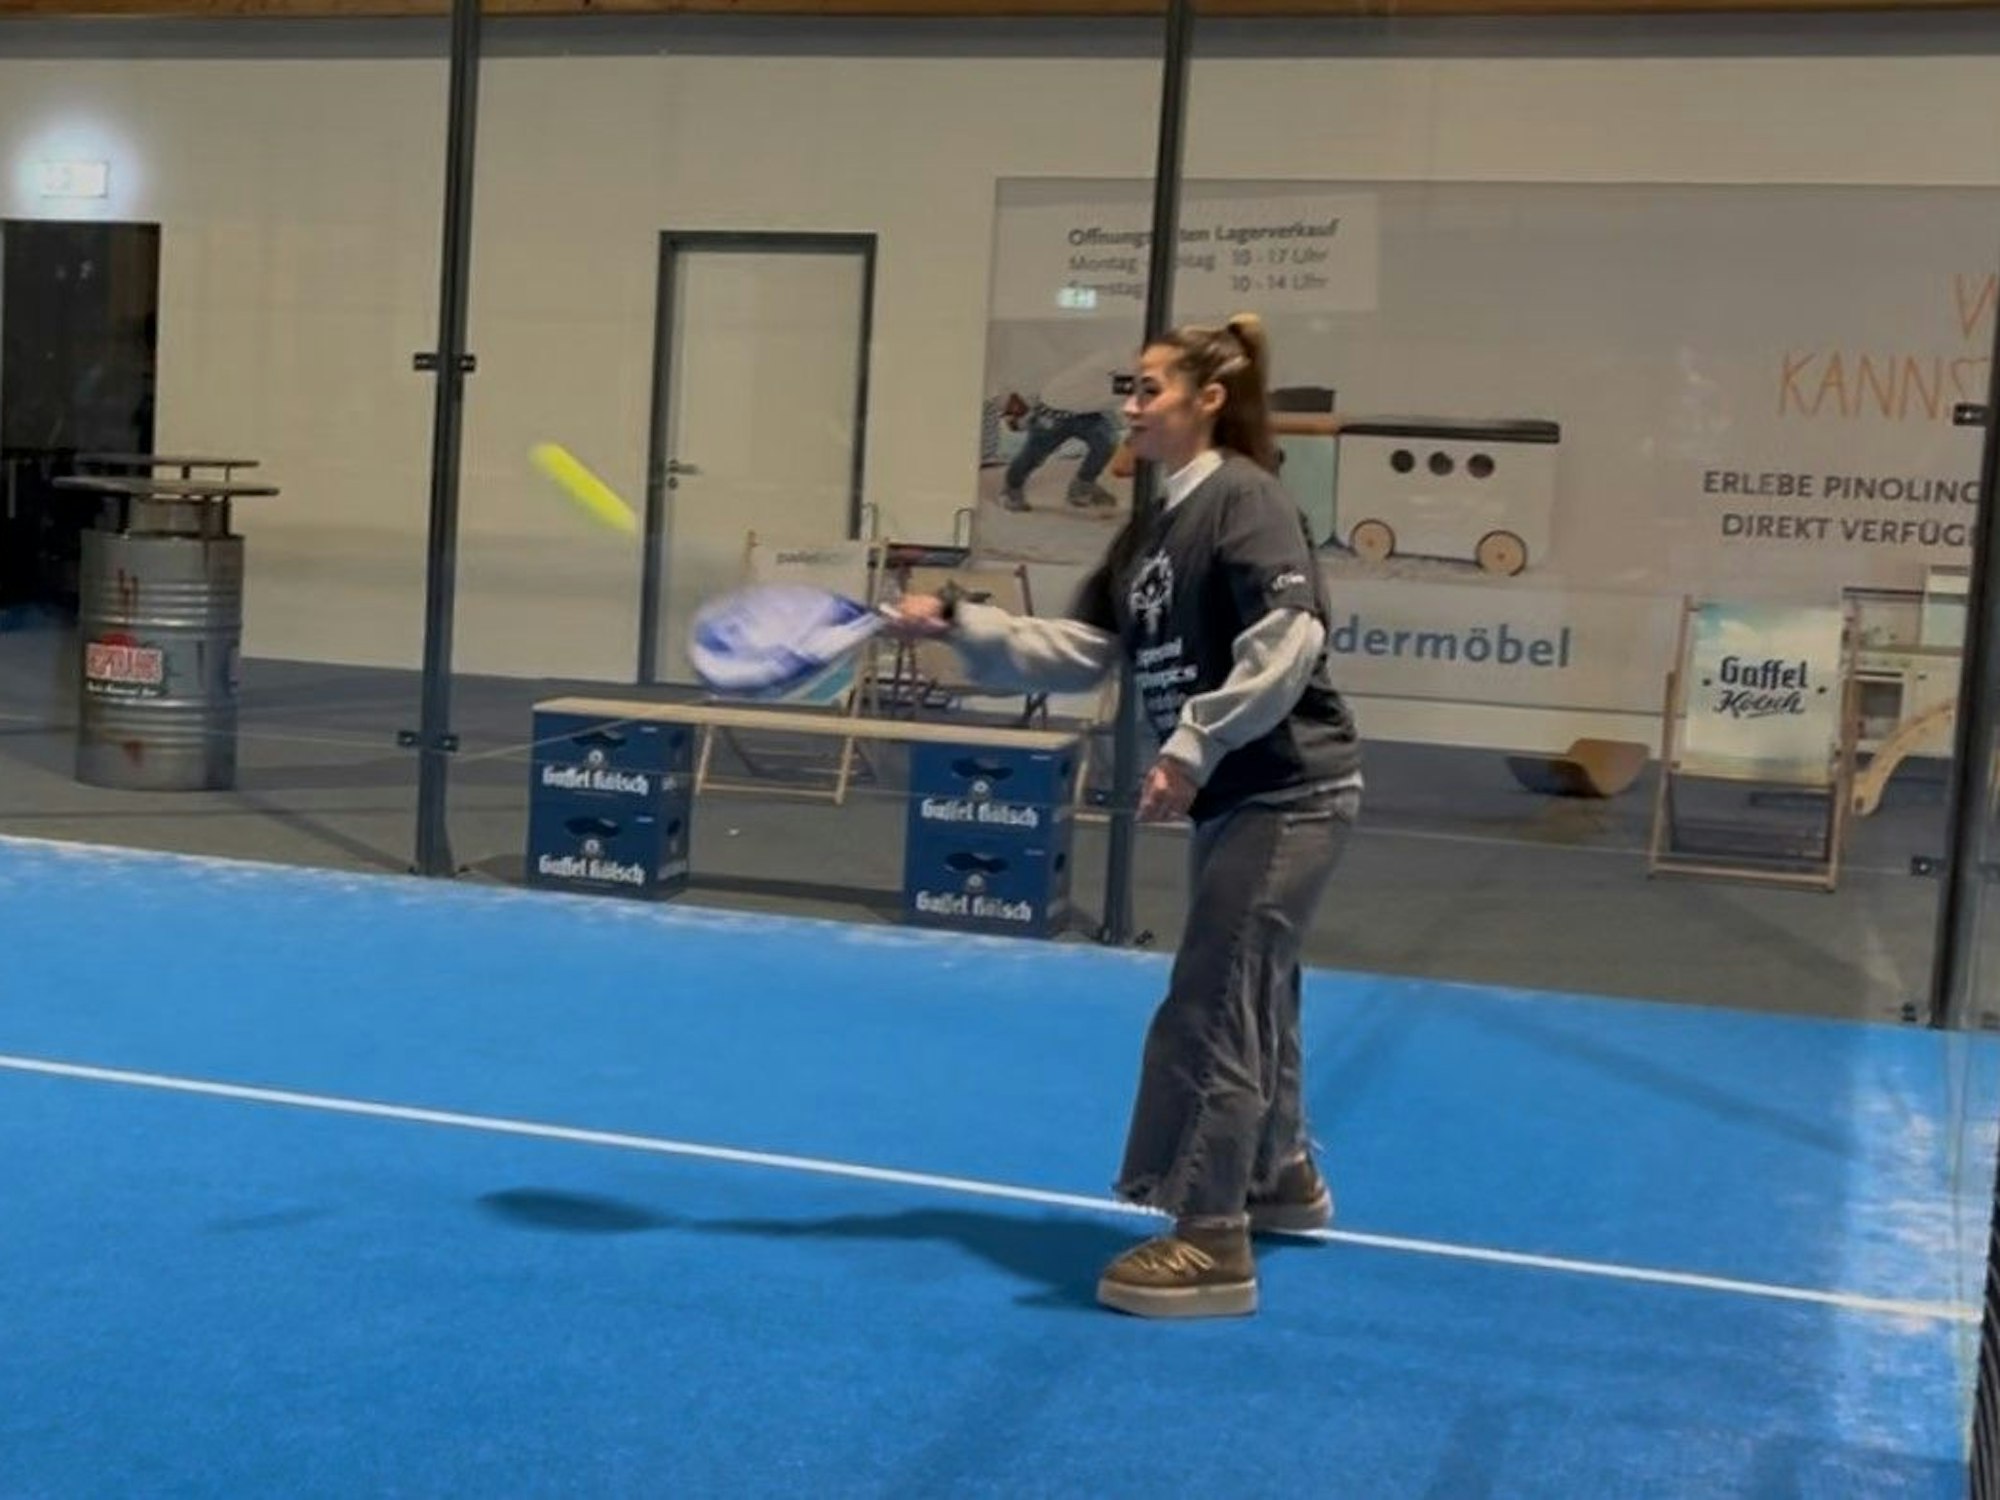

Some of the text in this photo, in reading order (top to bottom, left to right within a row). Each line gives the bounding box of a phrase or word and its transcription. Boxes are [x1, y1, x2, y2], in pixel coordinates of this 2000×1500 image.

[1777, 350, 1989, 420] KANNS
[1703, 470, 1814, 498] ERLEBE
[1721, 513, 1973, 547] DIREKT VERFÜG
[1331, 613, 1570, 668] dermöbel
[1720, 656, 1808, 690] Gaffel
